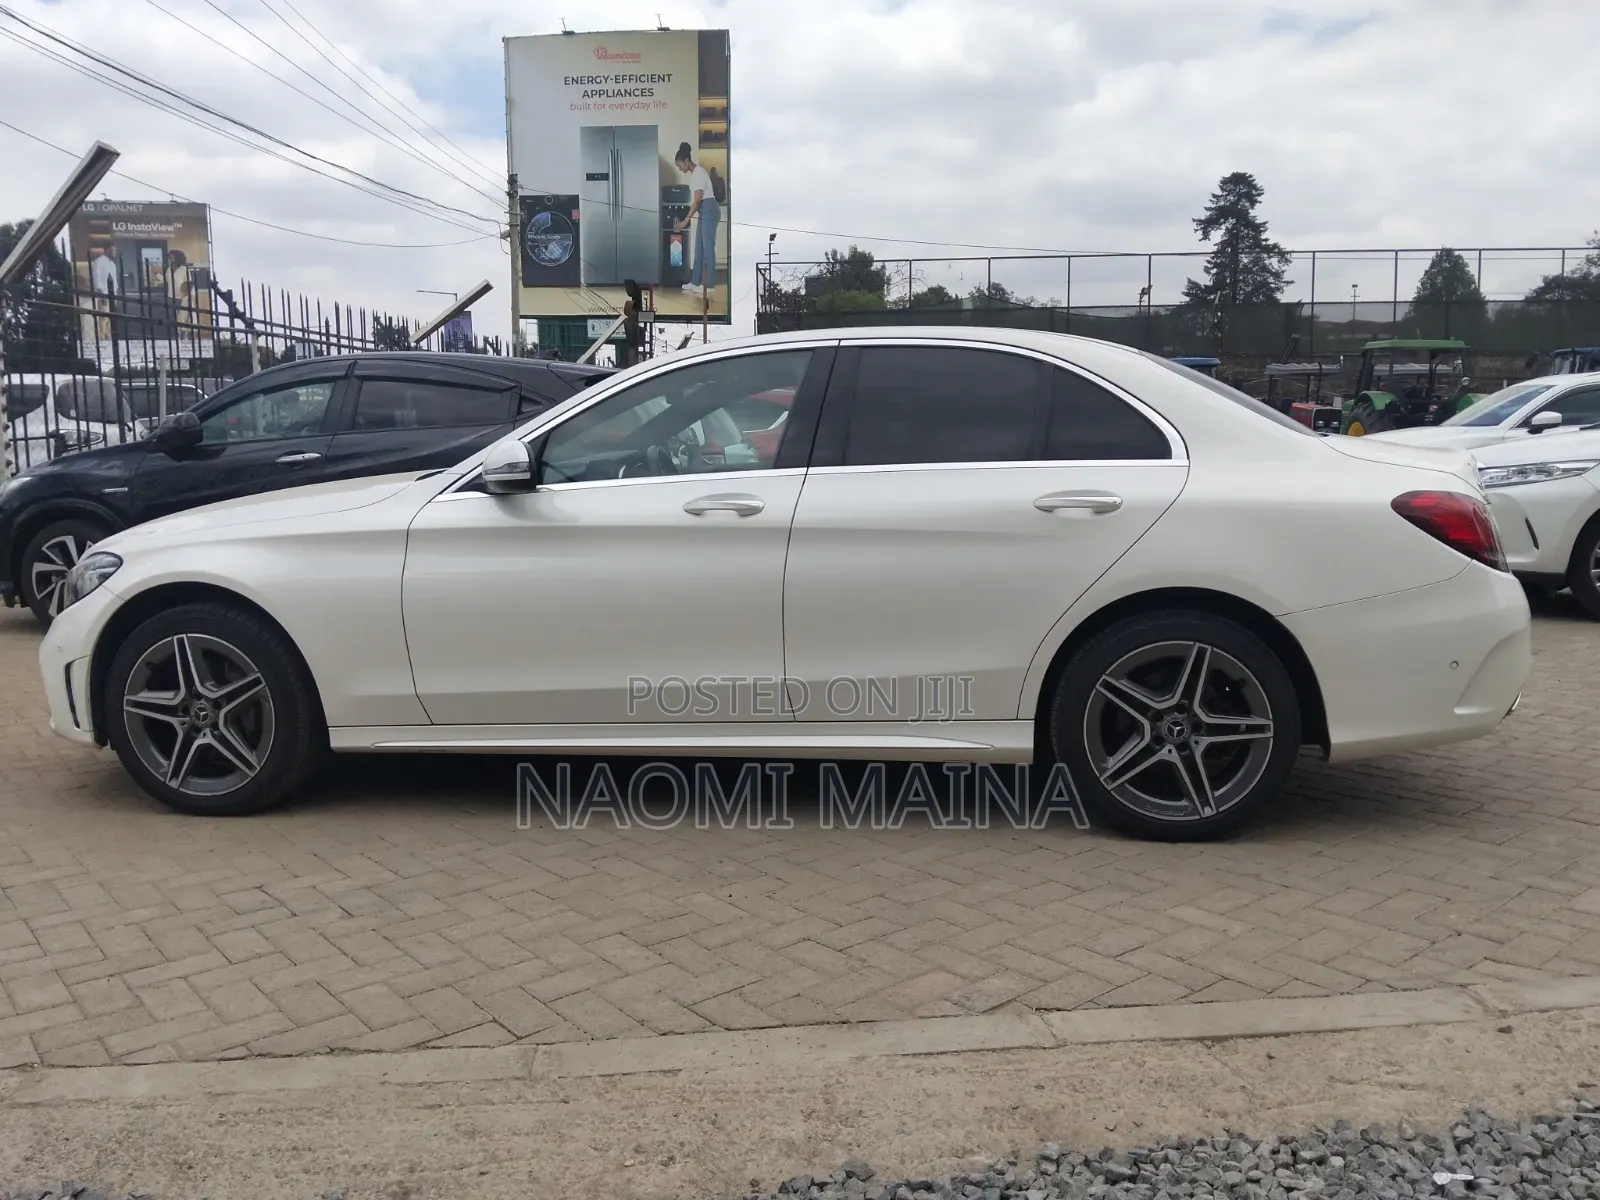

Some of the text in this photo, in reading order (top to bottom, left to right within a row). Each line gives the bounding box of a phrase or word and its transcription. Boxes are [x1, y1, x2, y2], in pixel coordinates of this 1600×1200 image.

[564, 74, 673, 85] ENERGY-EFFICIENT
[582, 88, 654, 98] APPLIANCES
[570, 100, 668, 111] built for everyday life
[82, 203, 95, 211] LG
[102, 203, 143, 212] OPALNET
[112, 222, 126, 231] LG
